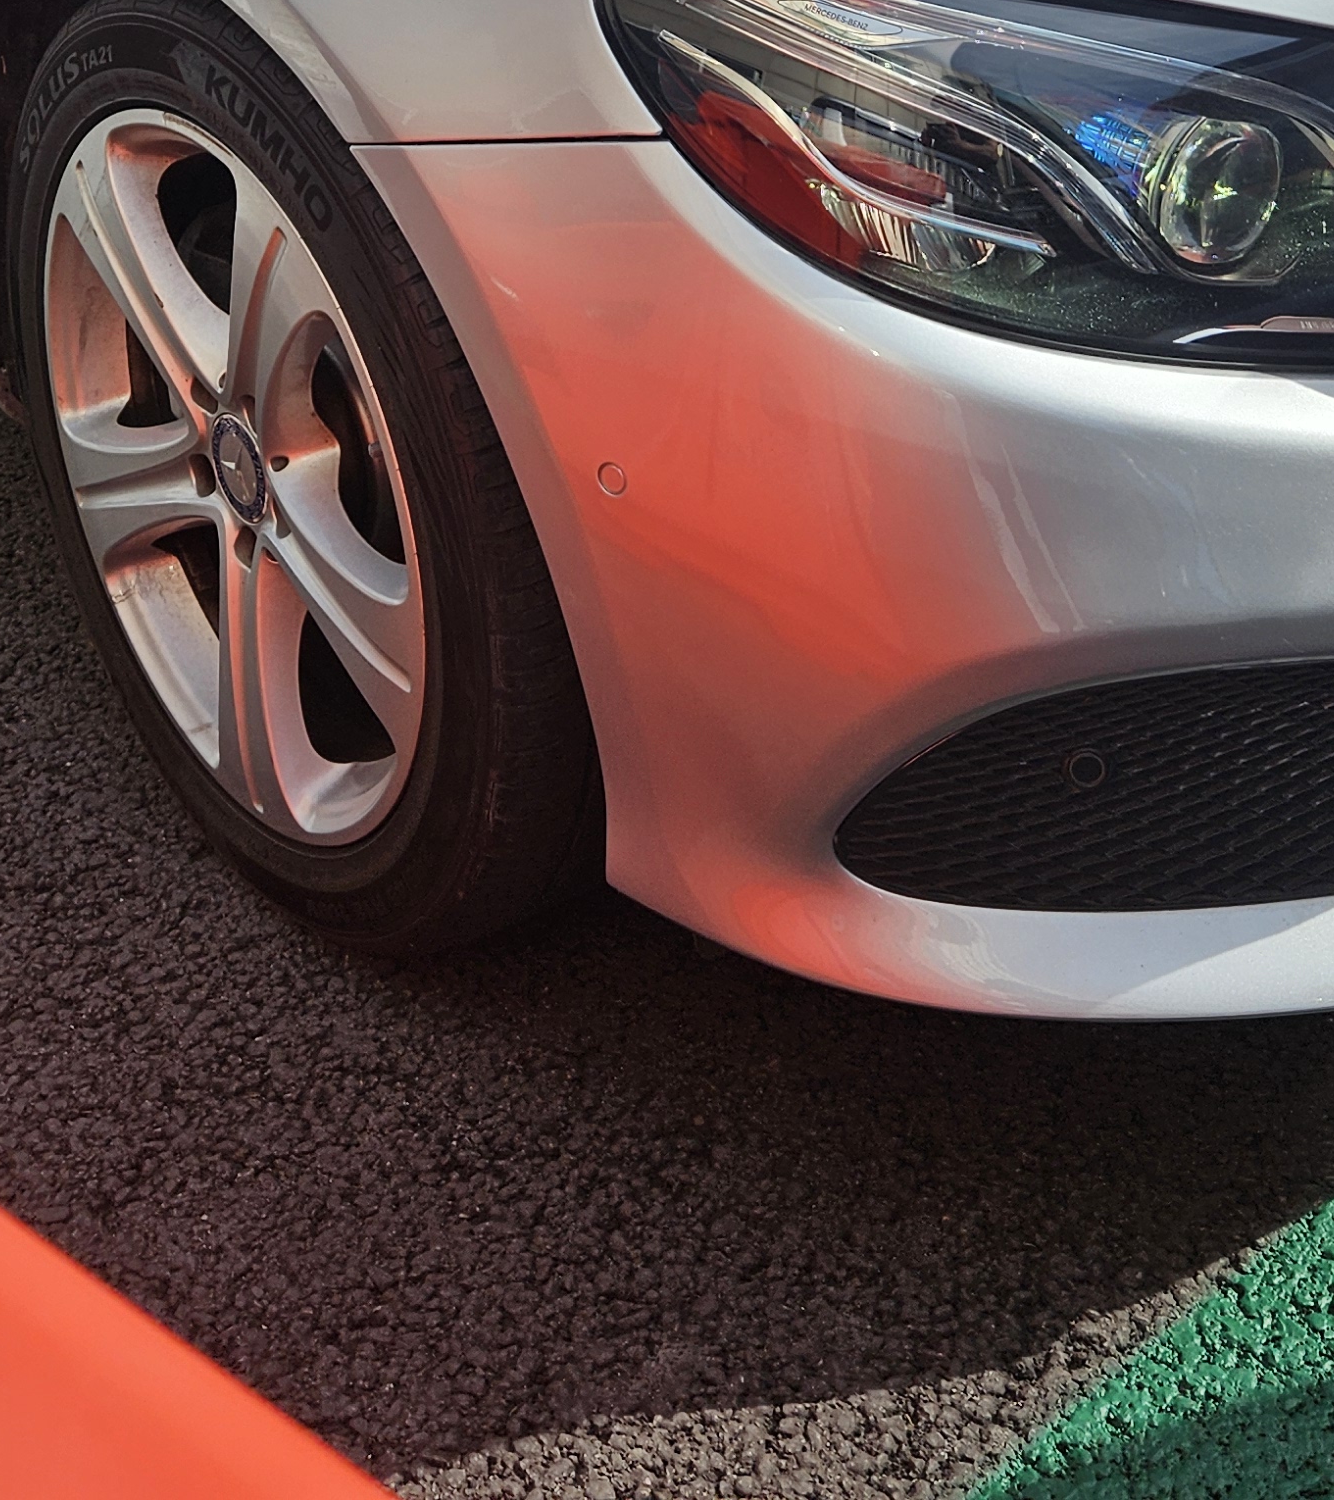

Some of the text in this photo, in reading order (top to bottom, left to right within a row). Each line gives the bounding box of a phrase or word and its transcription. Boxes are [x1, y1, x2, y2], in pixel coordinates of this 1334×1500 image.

[804, 3, 869, 31] MERCEDES-BENZ
[19, 44, 113, 174] SOLUS TA21
[204, 64, 334, 233] KUMHO
